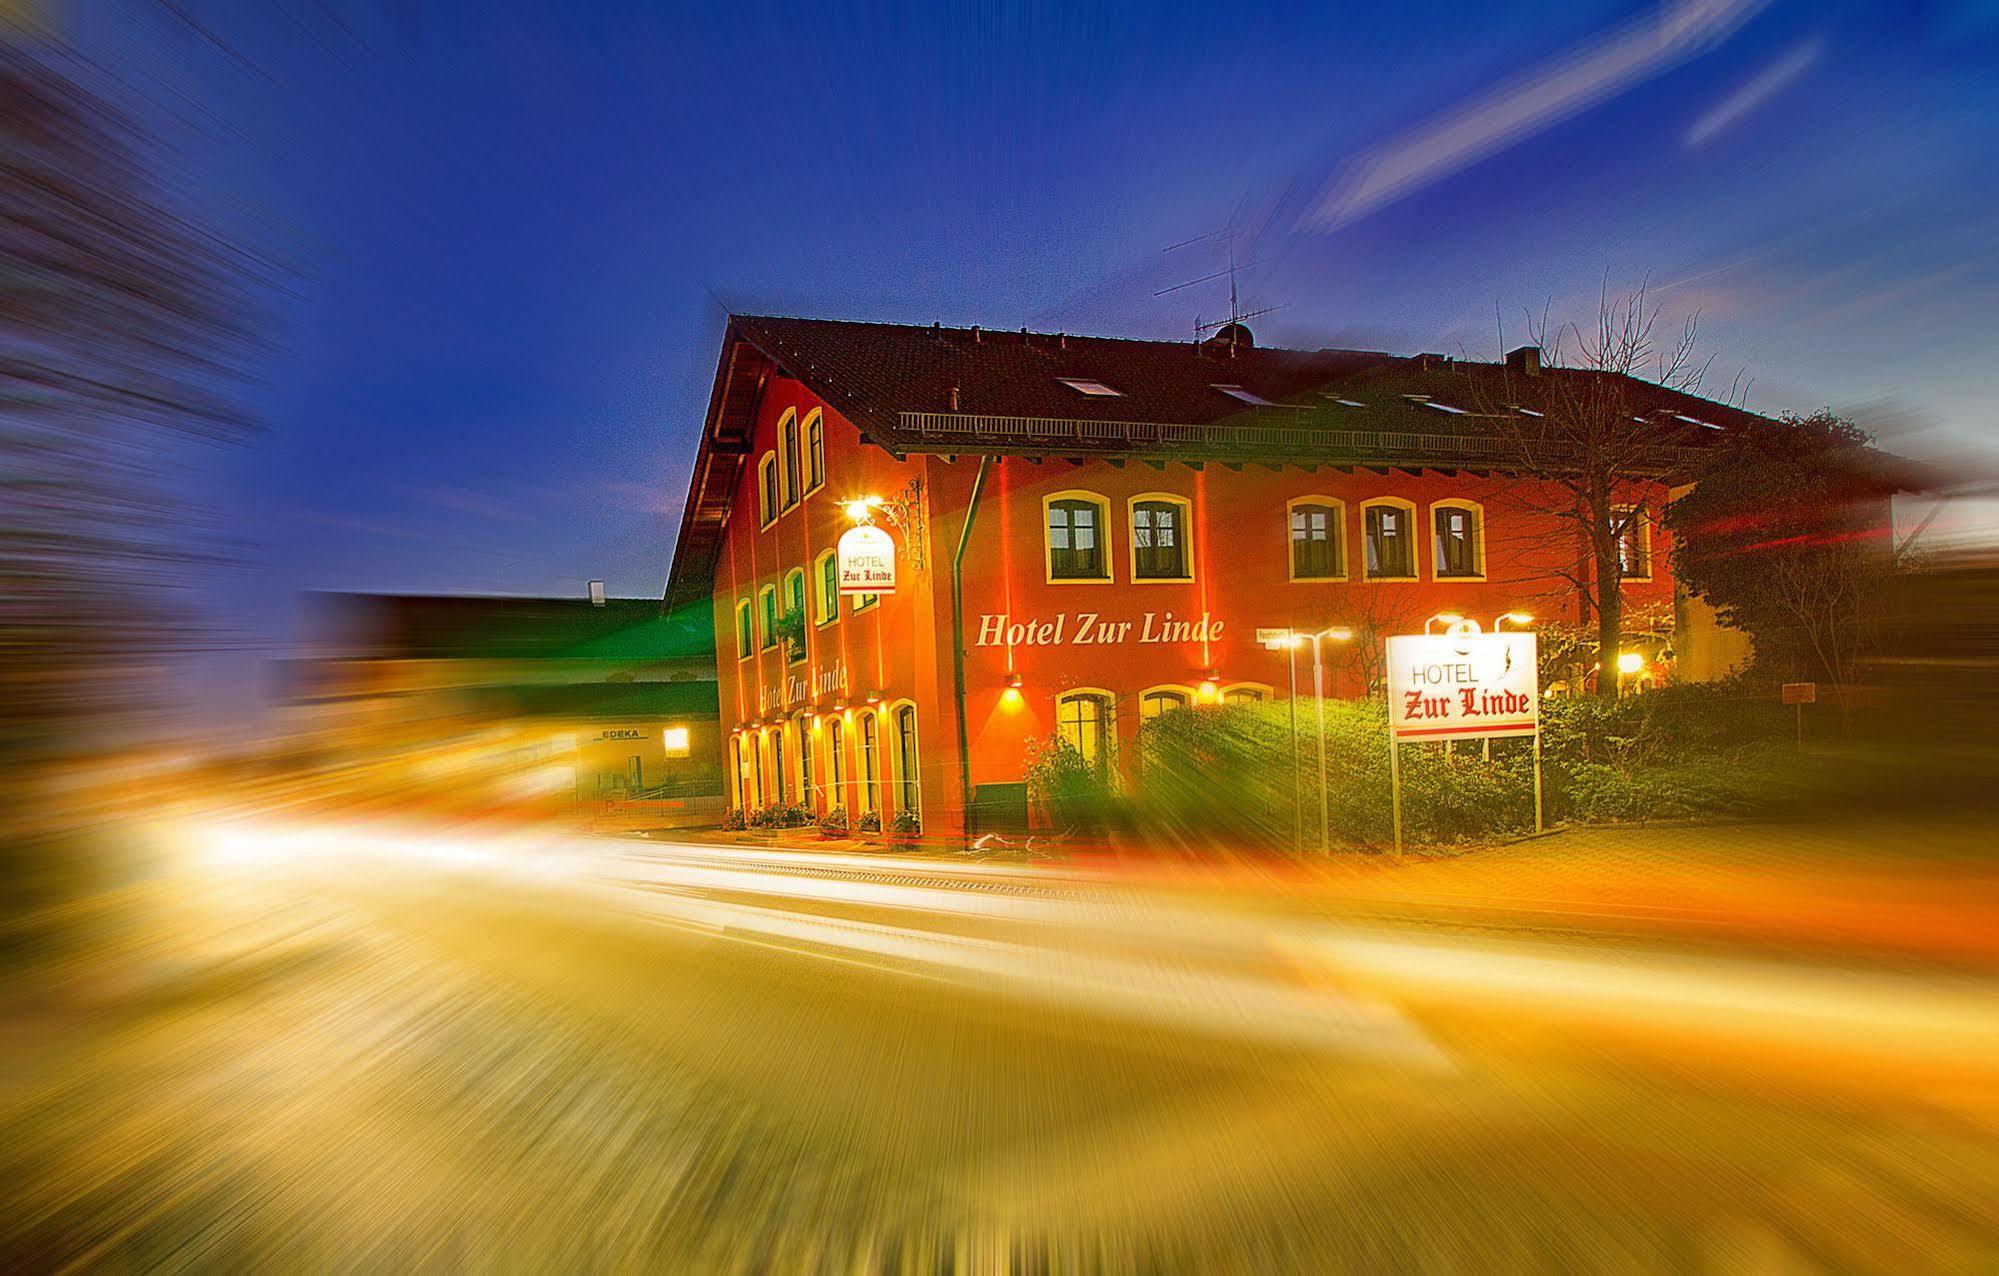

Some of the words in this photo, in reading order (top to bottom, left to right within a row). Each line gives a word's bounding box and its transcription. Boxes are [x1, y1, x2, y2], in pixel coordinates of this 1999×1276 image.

[848, 555, 885, 568] HOTEL
[843, 570, 861, 581] Zur
[864, 569, 892, 581] Linde
[975, 613, 1065, 646] Hotel
[1072, 613, 1131, 644] Zur
[1139, 612, 1224, 643] Linde
[787, 674, 808, 705] Zur
[811, 658, 848, 698] Linde
[1412, 664, 1479, 685] HOTEL
[1404, 690, 1451, 720] Zur
[1458, 687, 1530, 717] Linde
[602, 730, 640, 739] EDEKA
